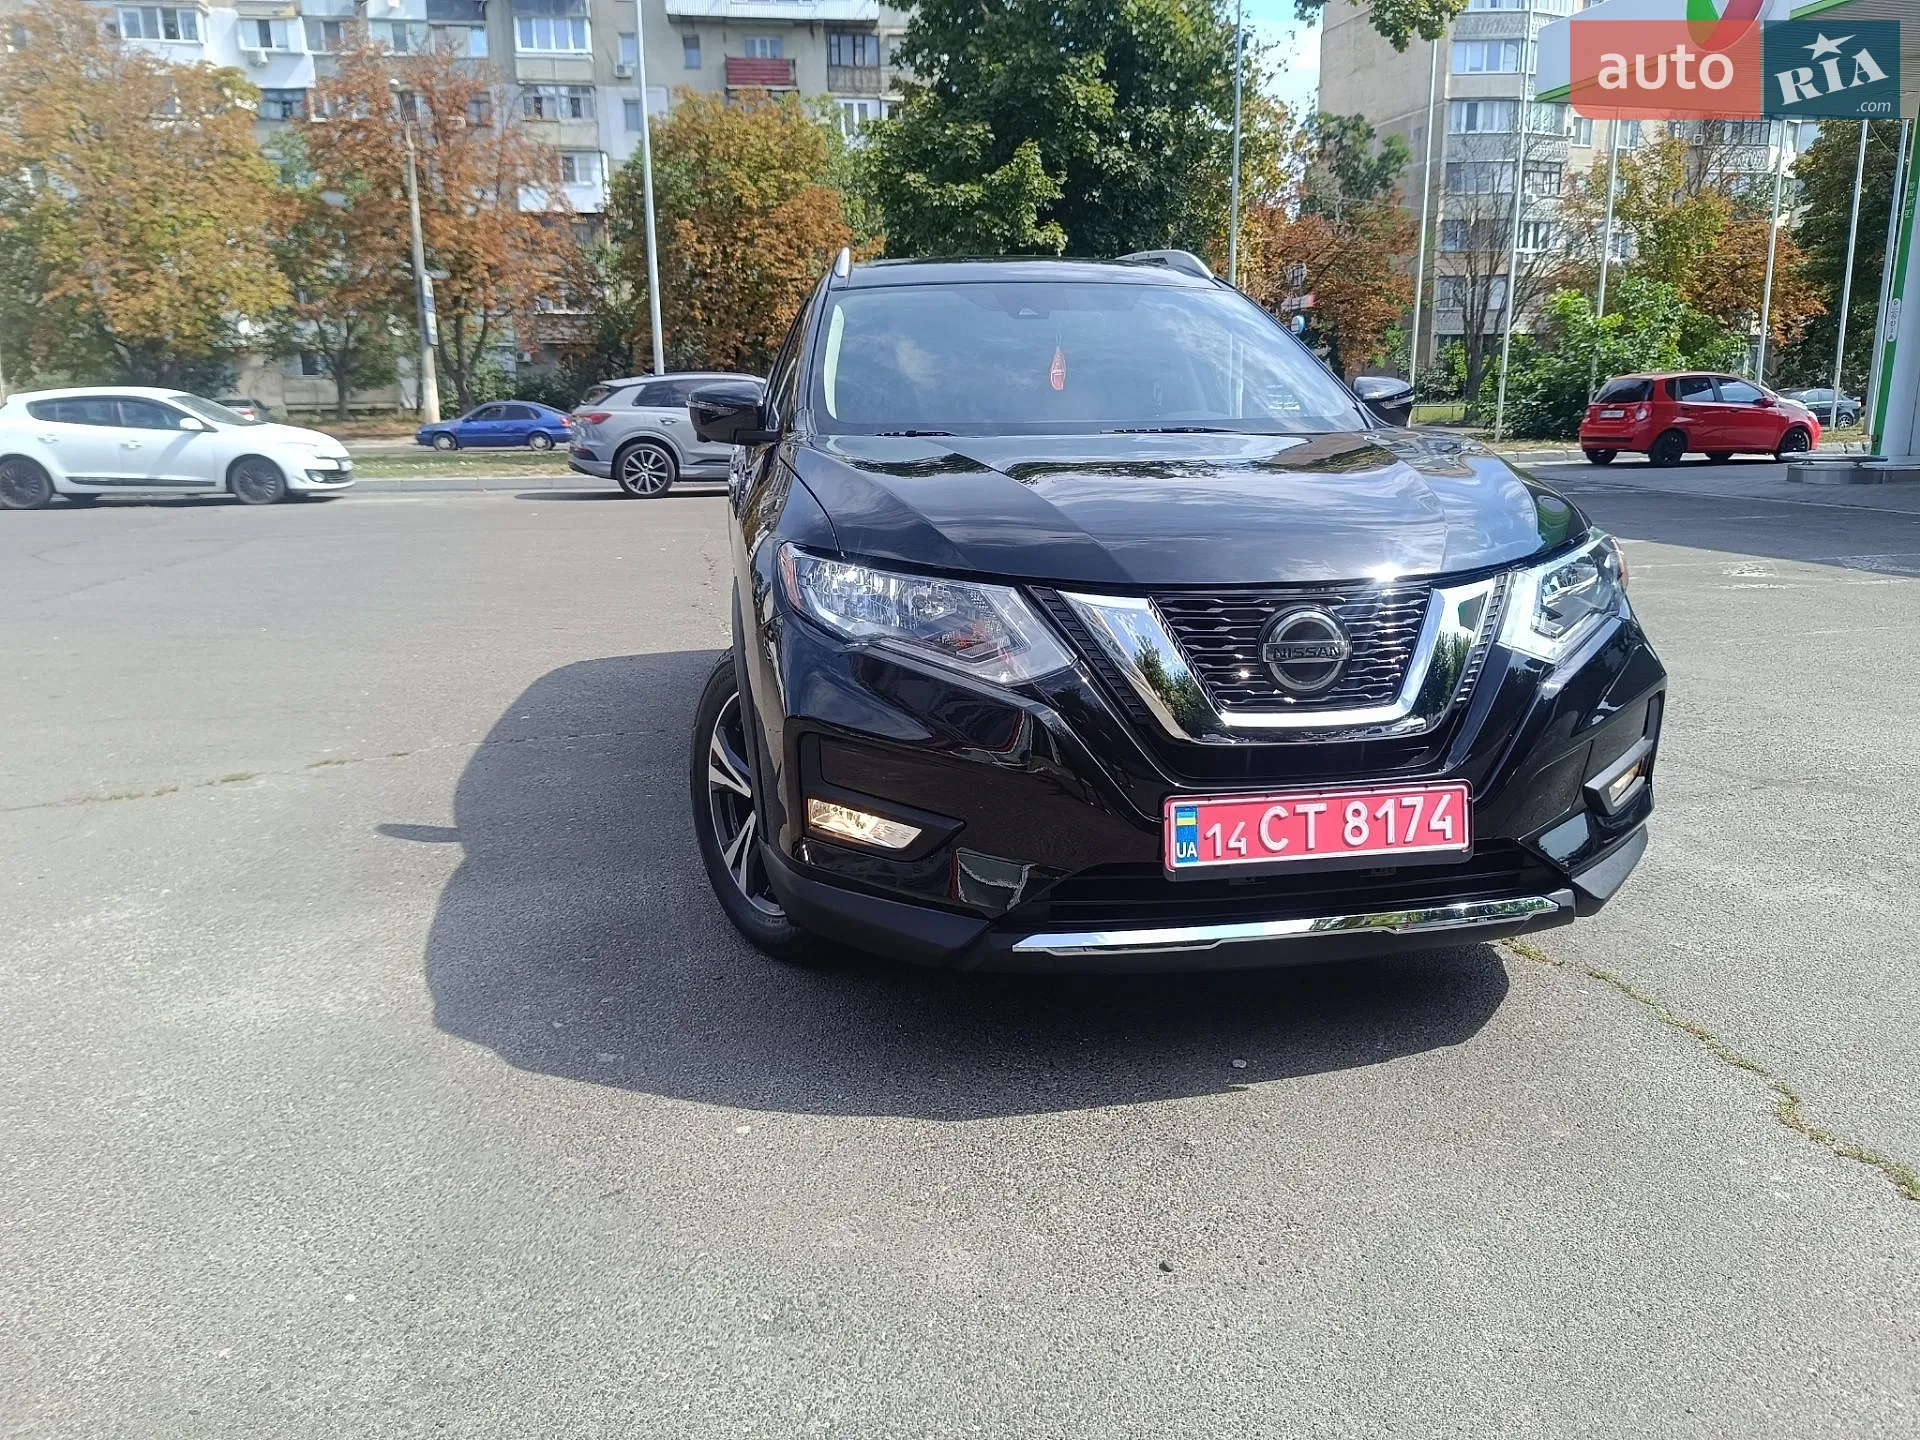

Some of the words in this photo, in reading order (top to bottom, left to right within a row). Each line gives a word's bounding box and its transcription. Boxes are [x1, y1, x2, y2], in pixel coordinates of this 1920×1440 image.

[1272, 646, 1341, 660] NISSAN
[1342, 794, 1454, 846] 8174
[1176, 842, 1198, 858] UA
